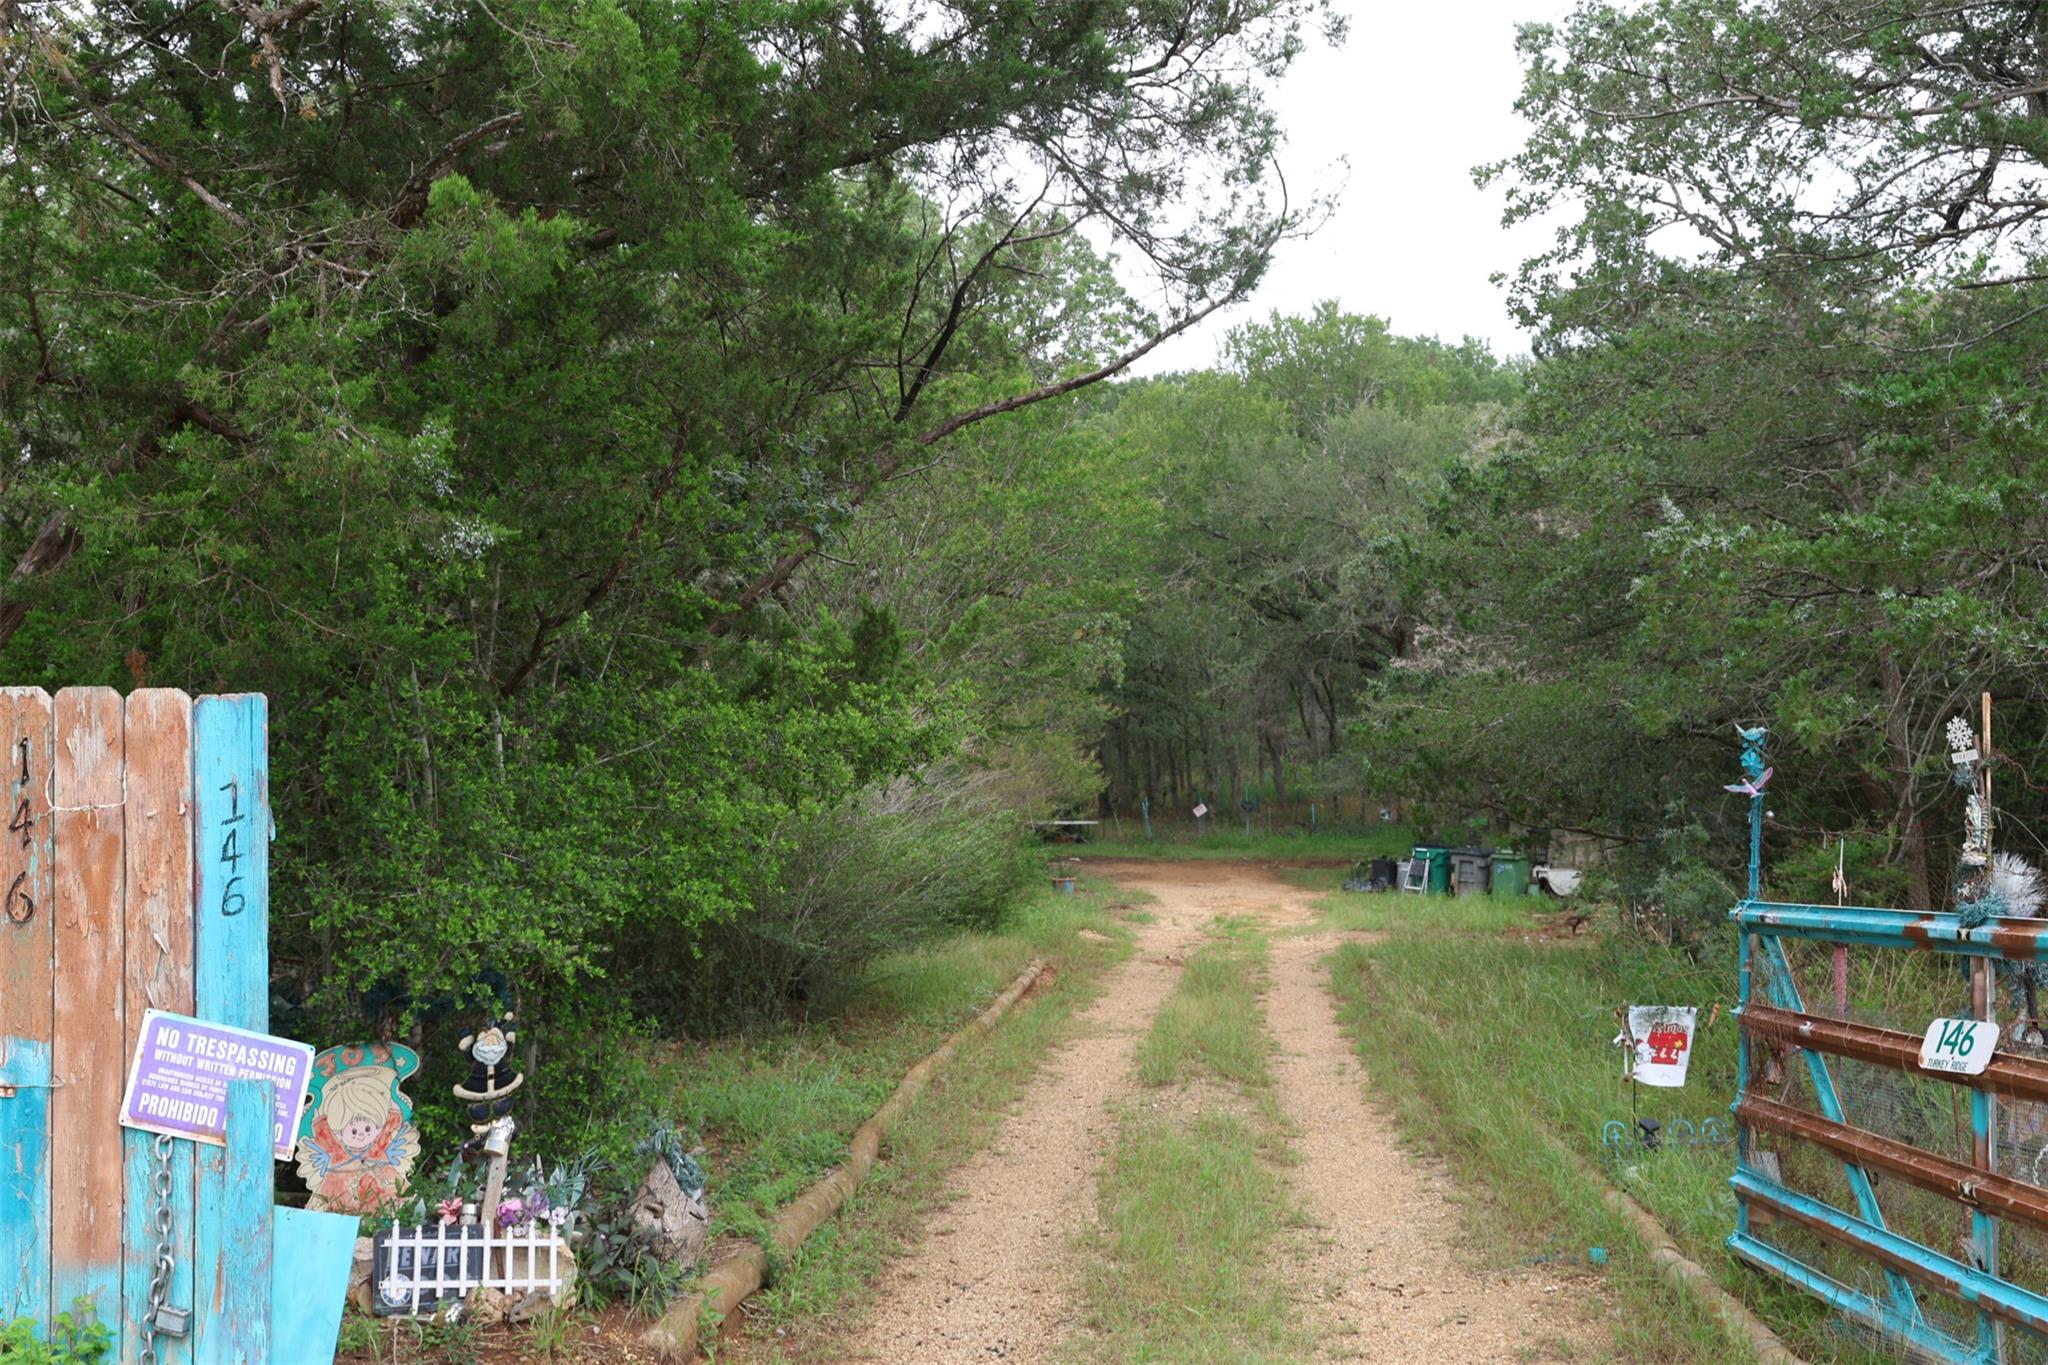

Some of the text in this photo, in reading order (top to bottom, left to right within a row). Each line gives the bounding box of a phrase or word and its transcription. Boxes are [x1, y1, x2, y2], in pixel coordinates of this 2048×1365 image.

[6, 737, 34, 926] 146
[219, 782, 246, 917] 146
[157, 1028, 297, 1076] NO TRESPASSING
[1936, 1020, 1978, 1056] 146
[154, 1048, 194, 1067] WITHOUT
[197, 1057, 236, 1077] WRITTEN
[138, 1093, 218, 1127] PROHIBIDO
